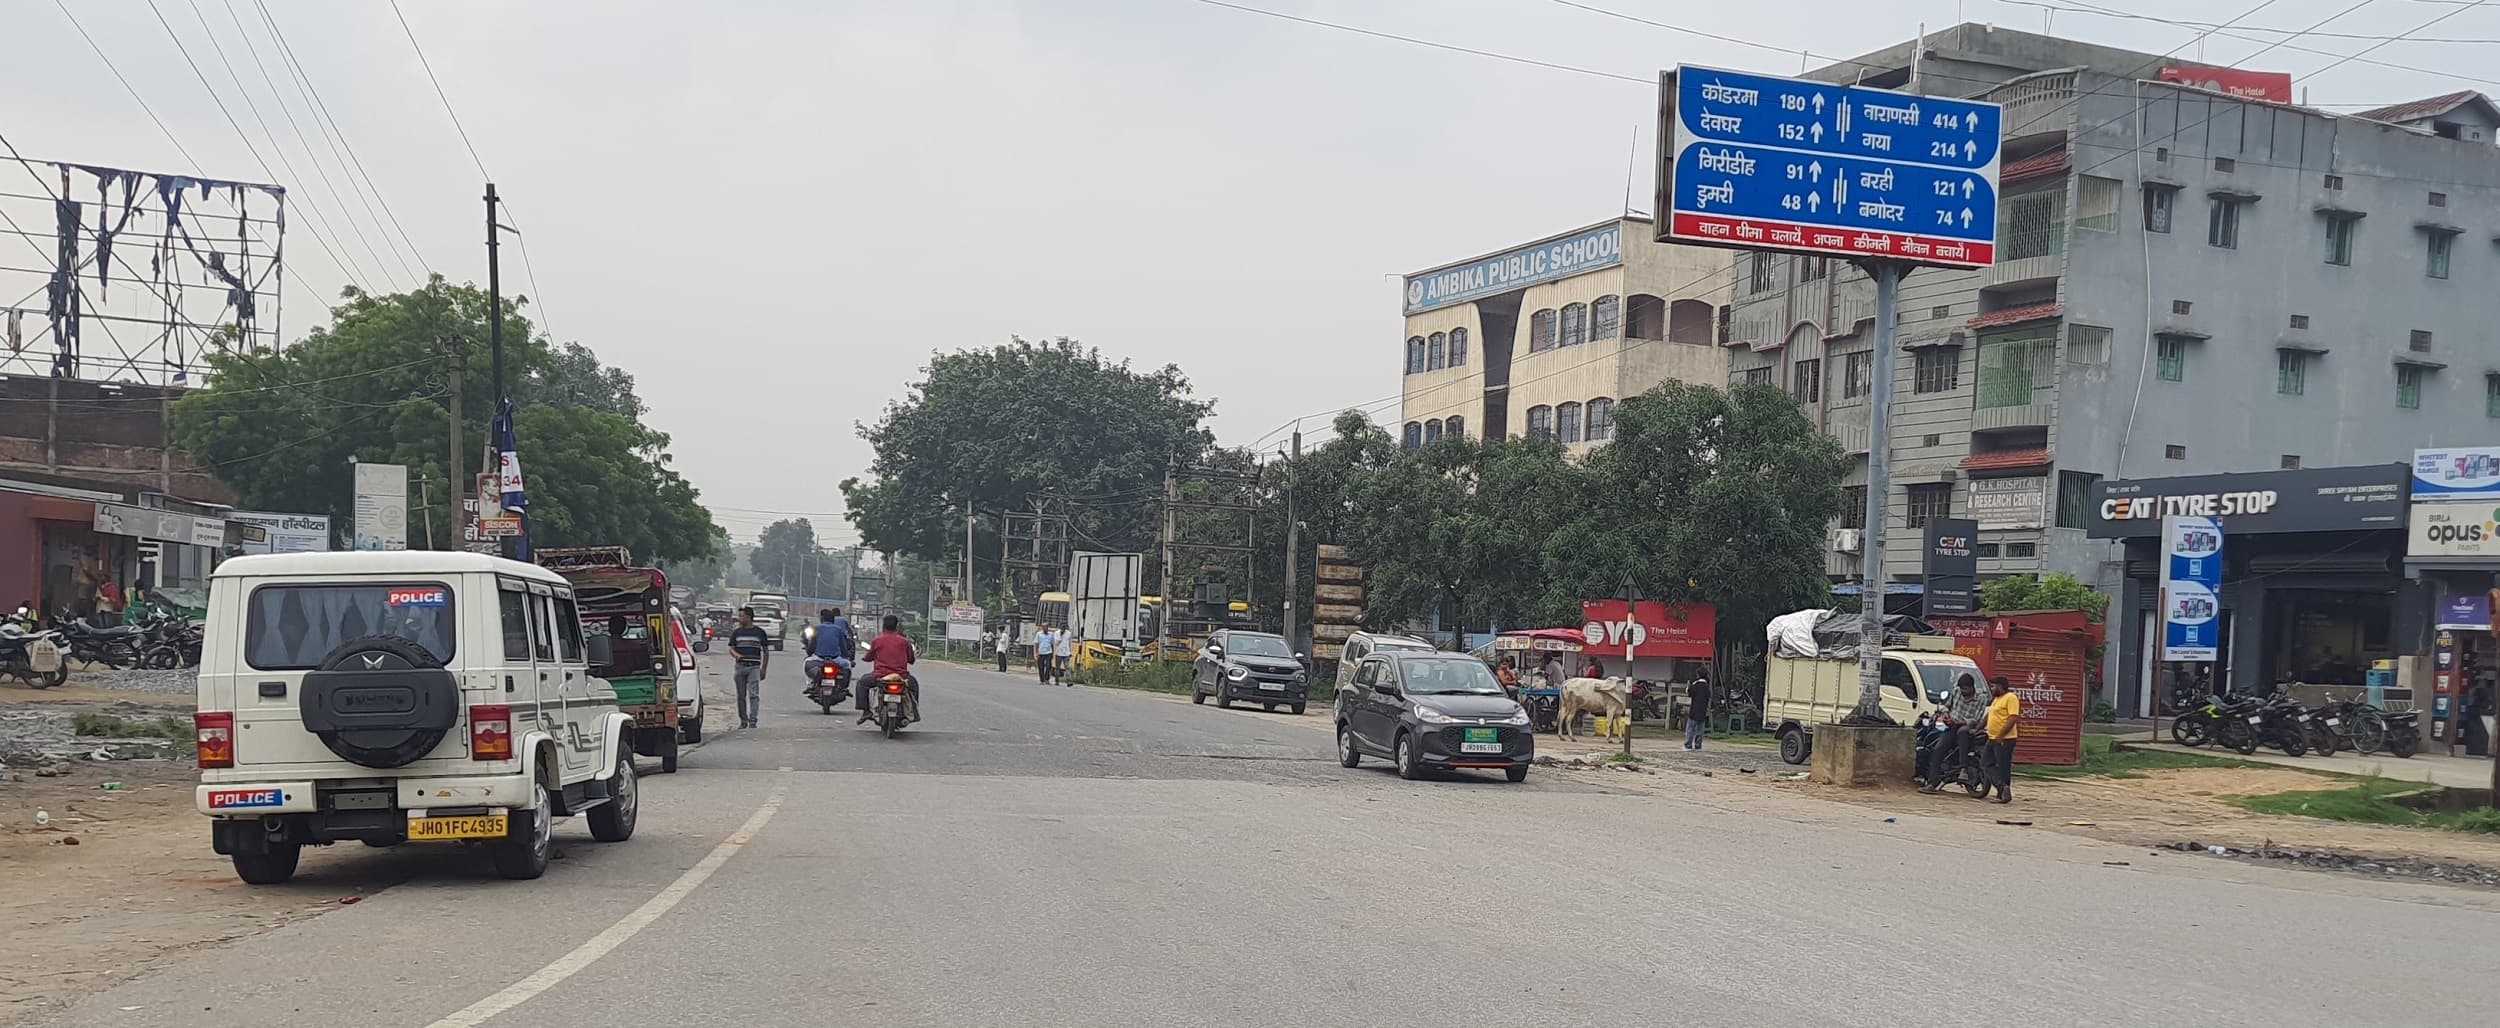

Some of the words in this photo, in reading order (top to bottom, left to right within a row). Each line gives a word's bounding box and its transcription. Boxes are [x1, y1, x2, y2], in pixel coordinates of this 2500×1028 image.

[1702, 77, 1758, 106] कोडरमा
[1780, 94, 1806, 111] 180
[1700, 106, 1742, 134] देवघर
[1778, 123, 1804, 141] 152
[1863, 103, 1920, 126] वाराणसी
[1932, 113, 1958, 130] 414
[1862, 133, 1892, 152] गया
[1930, 141, 1957, 158] 214
[1698, 147, 1756, 176] गिरीडीह
[1786, 164, 1804, 180] 91
[1860, 167, 1894, 191] बरही
[1933, 180, 1956, 196] 121
[1697, 180, 1734, 208] डुमरी
[1781, 194, 1801, 210] 48
[1859, 196, 1905, 222] बगोदर
[1936, 210, 1954, 226] 74
[1699, 222, 1729, 236] वाहन
[1736, 221, 1763, 240] धीमा
[1813, 233, 1844, 248] अपना
[1854, 232, 1891, 252] कीमती
[1900, 239, 1930, 256] जीवन
[1427, 266, 1485, 299] AMBIKA
[1489, 250, 1547, 285] PUBLIC
[1550, 230, 1620, 270] SCHOOL
[1996, 478, 2040, 490] HOSPITAL
[1974, 494, 2012, 508] RESEARCH
[2013, 492, 2042, 507] CENTRE
[2101, 497, 2154, 520] CEAT
[2164, 494, 2218, 517] TYRE
[2221, 491, 2278, 515] STOP
[2428, 514, 2451, 523] BIRLA
[1939, 536, 1967, 548] CEAT
[2427, 524, 2481, 545] opus
[1934, 548, 1953, 556] TYRE
[1953, 549, 1971, 557] STOP
[390, 592, 444, 603] POLICE
[214, 792, 275, 805] POLICE
[417, 819, 504, 835] JH01FC4935
